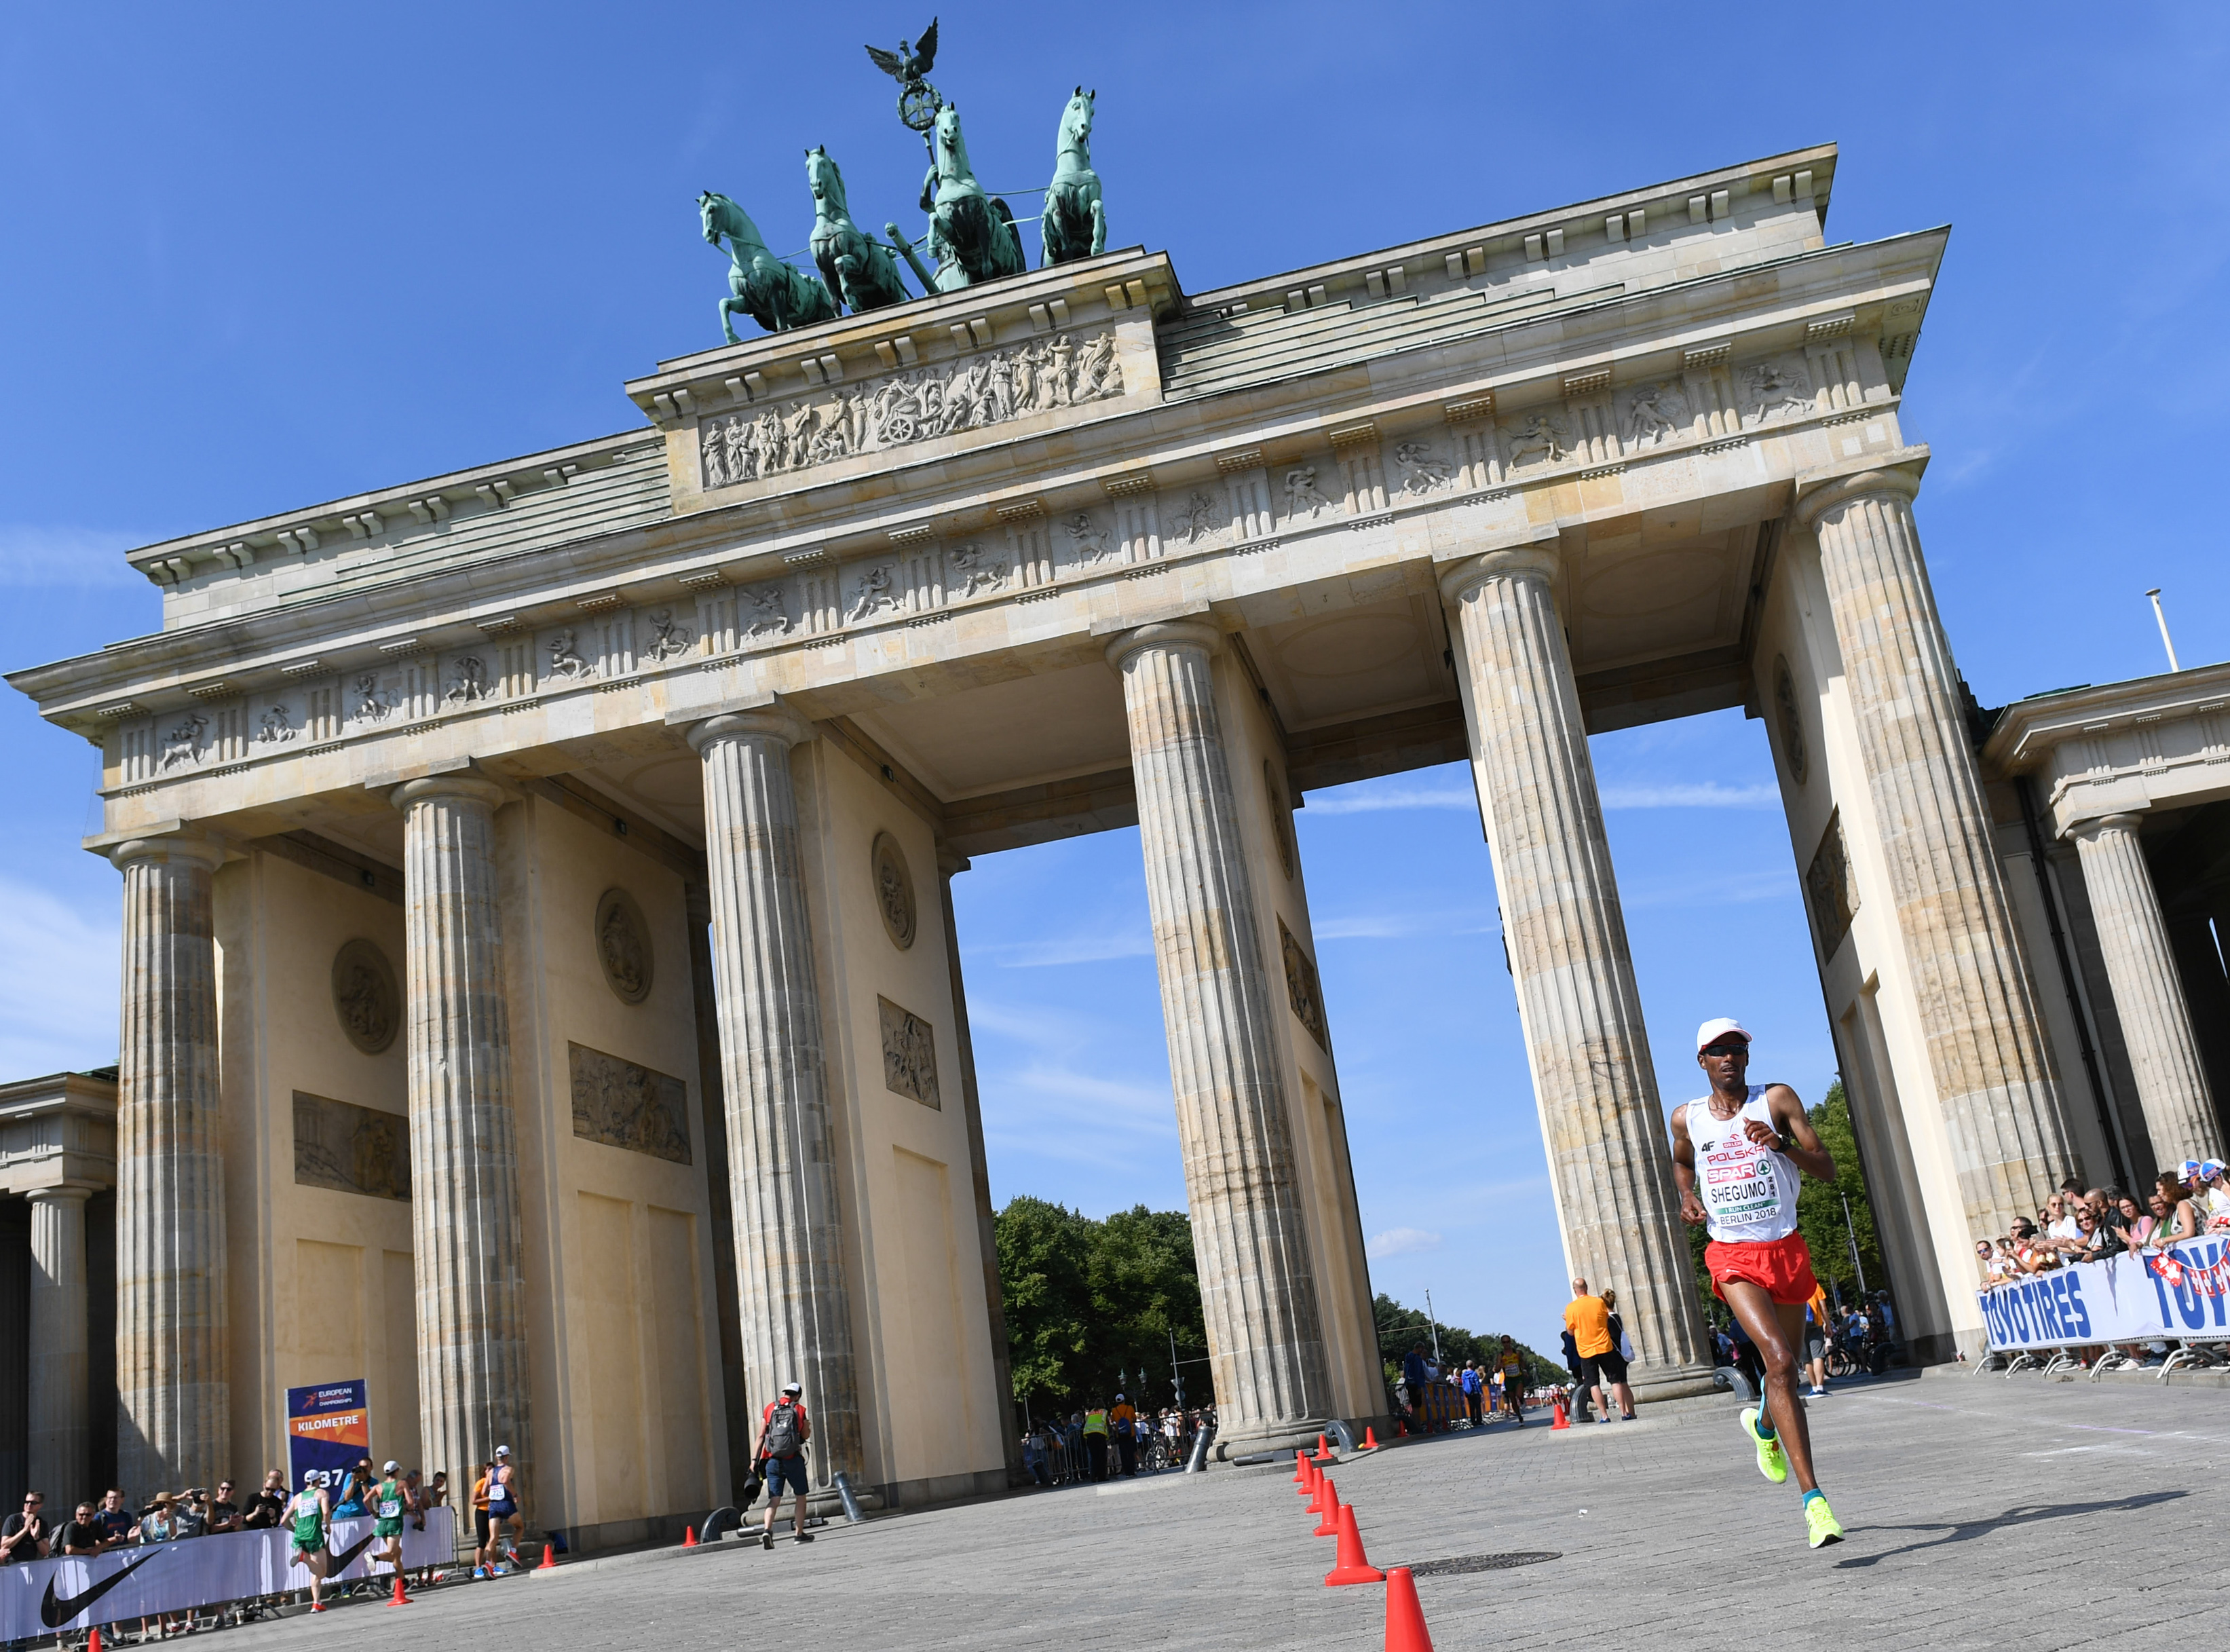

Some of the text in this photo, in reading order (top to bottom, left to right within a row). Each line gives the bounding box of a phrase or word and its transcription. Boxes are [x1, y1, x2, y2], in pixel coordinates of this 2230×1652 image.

[1707, 1145, 1764, 1165] POLSKA
[1708, 1165, 1754, 1182] SPAR
[1711, 1181, 1766, 1203] SHEGUMO
[1744, 1202, 1764, 1210] CLEAN
[1720, 1207, 1777, 1225] BERLIN 2018
[318, 1387, 352, 1397] EUROPEAN
[298, 1415, 359, 1431] KILOMETRE
[319, 1469, 343, 1488] 37
